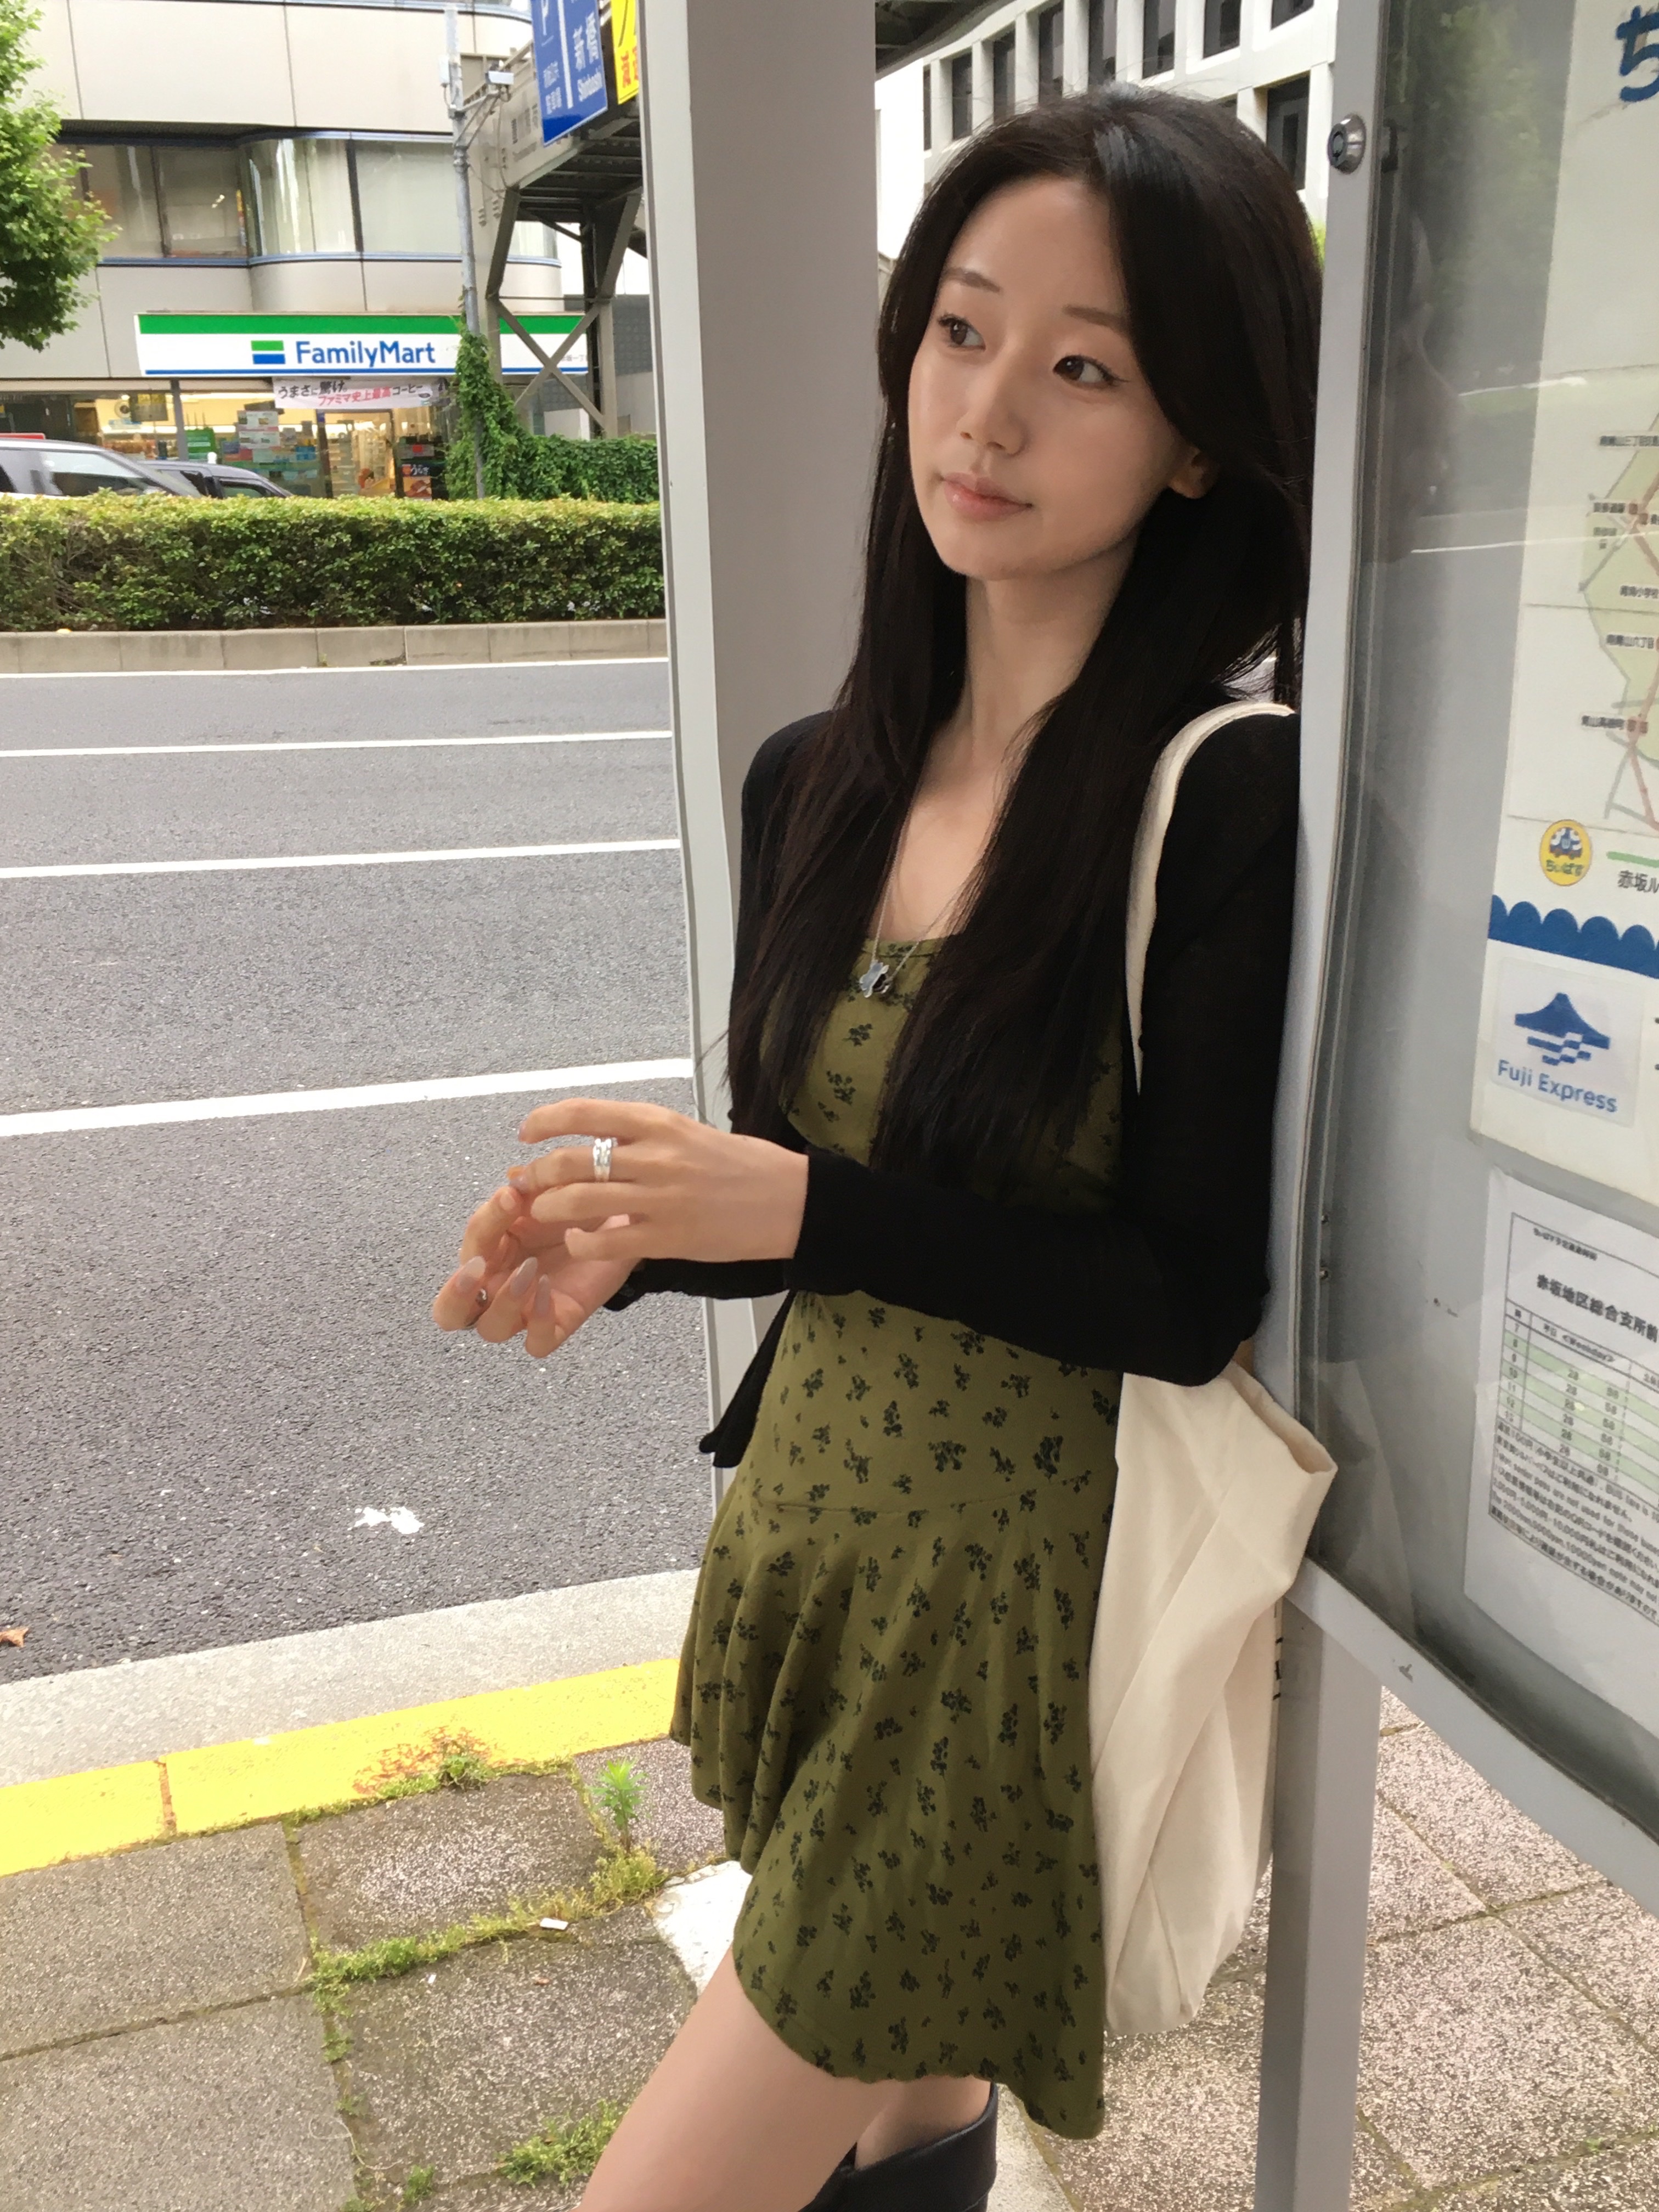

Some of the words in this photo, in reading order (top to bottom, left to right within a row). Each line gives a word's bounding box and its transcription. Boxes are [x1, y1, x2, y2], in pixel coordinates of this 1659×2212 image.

[296, 340, 436, 368] FamilyMart
[1498, 1059, 1532, 1087] Fuji
[1538, 1072, 1618, 1113] Express
[1537, 1273, 1658, 1344] 赤坂地区総合支所前
